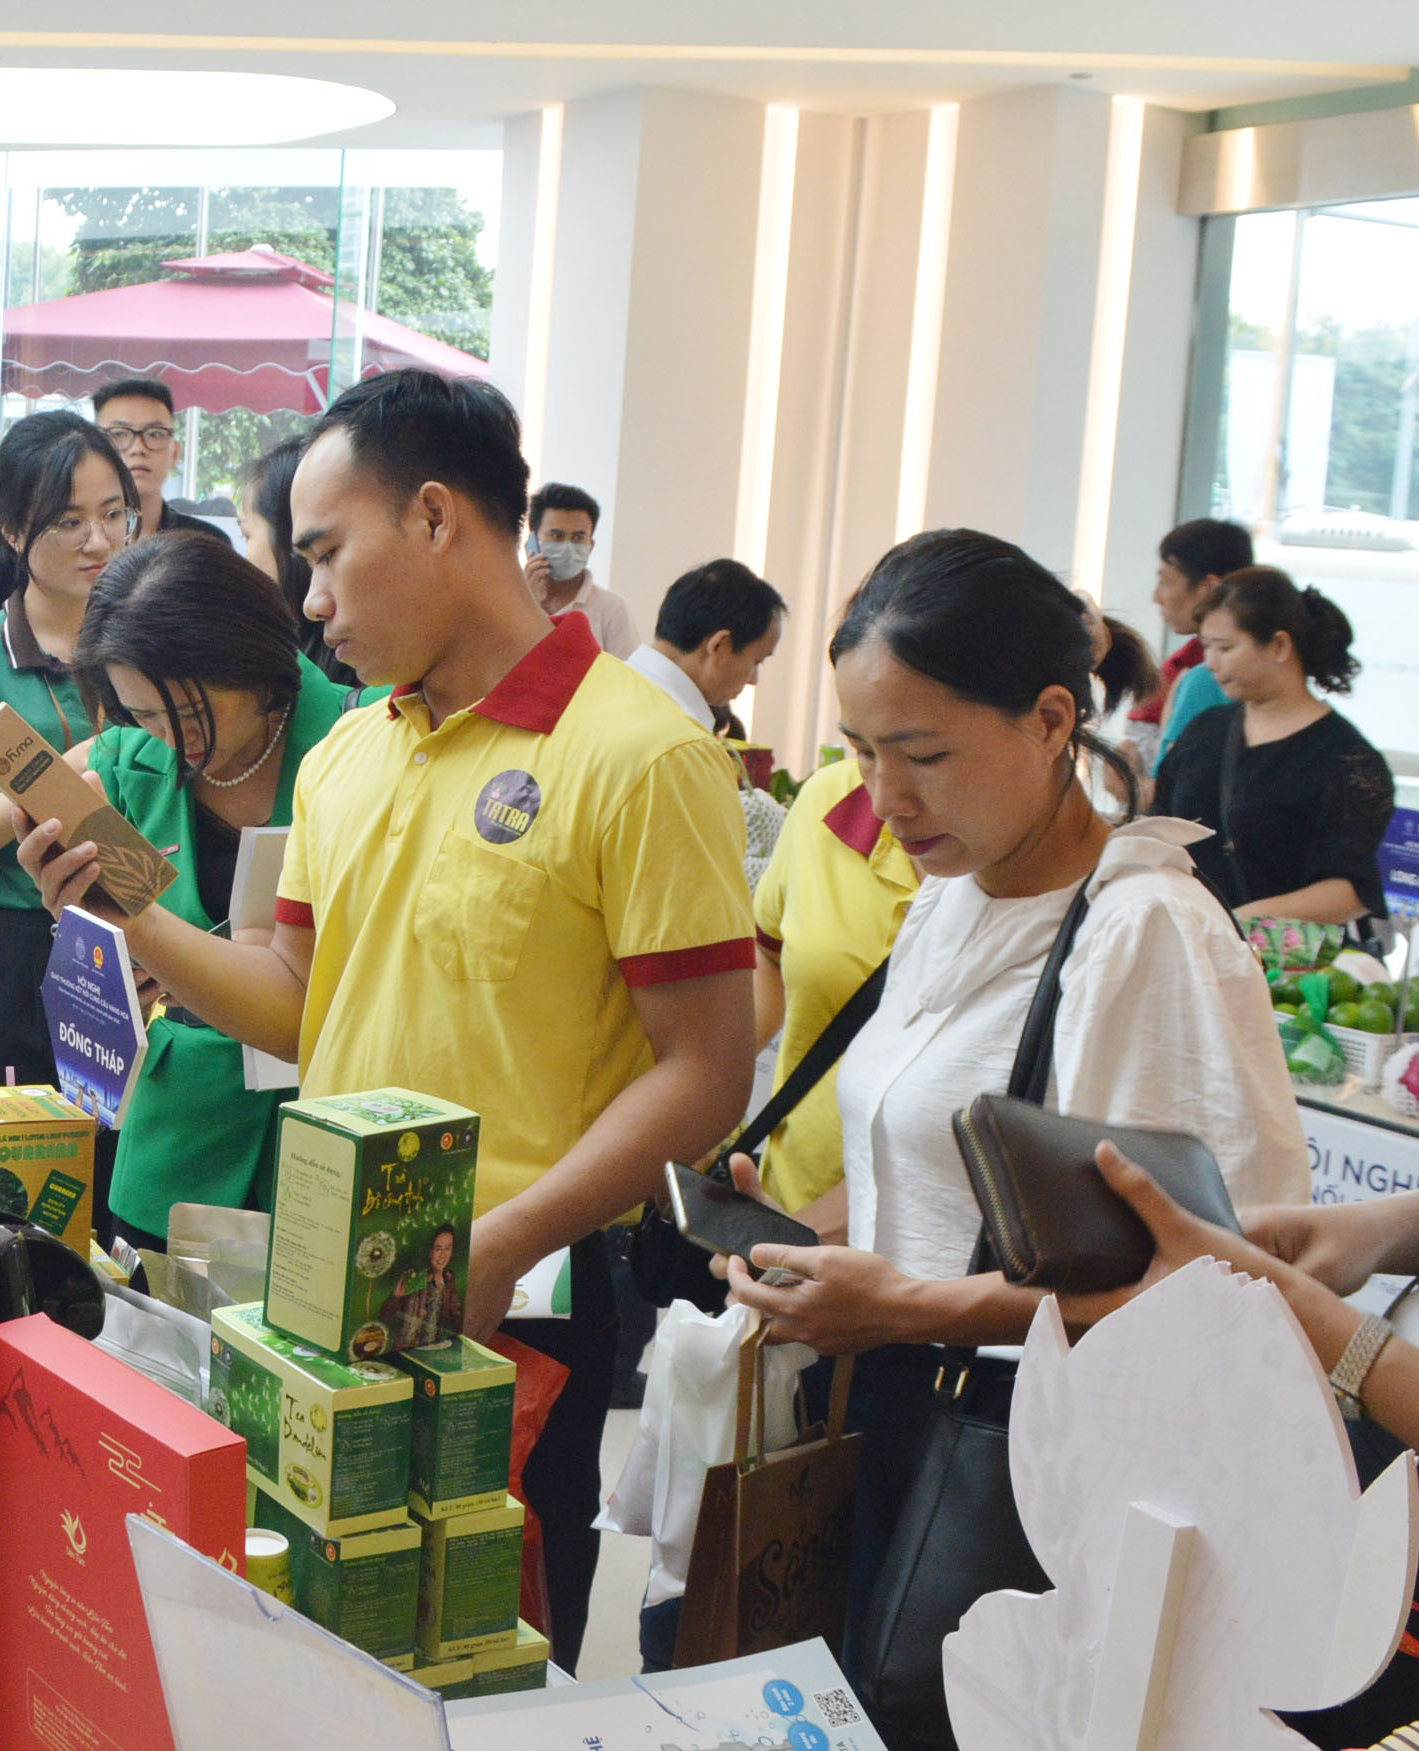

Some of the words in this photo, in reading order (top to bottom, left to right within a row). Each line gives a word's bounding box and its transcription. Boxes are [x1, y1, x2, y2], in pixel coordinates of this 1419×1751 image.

[482, 797, 531, 833] TATRA
[59, 1021, 92, 1058] ĐỒNG
[94, 1042, 125, 1077] THÁP
[1341, 1153, 1419, 1196] NGH
[285, 1393, 305, 1423] Tea
[283, 1415, 327, 1461] Dandelion
